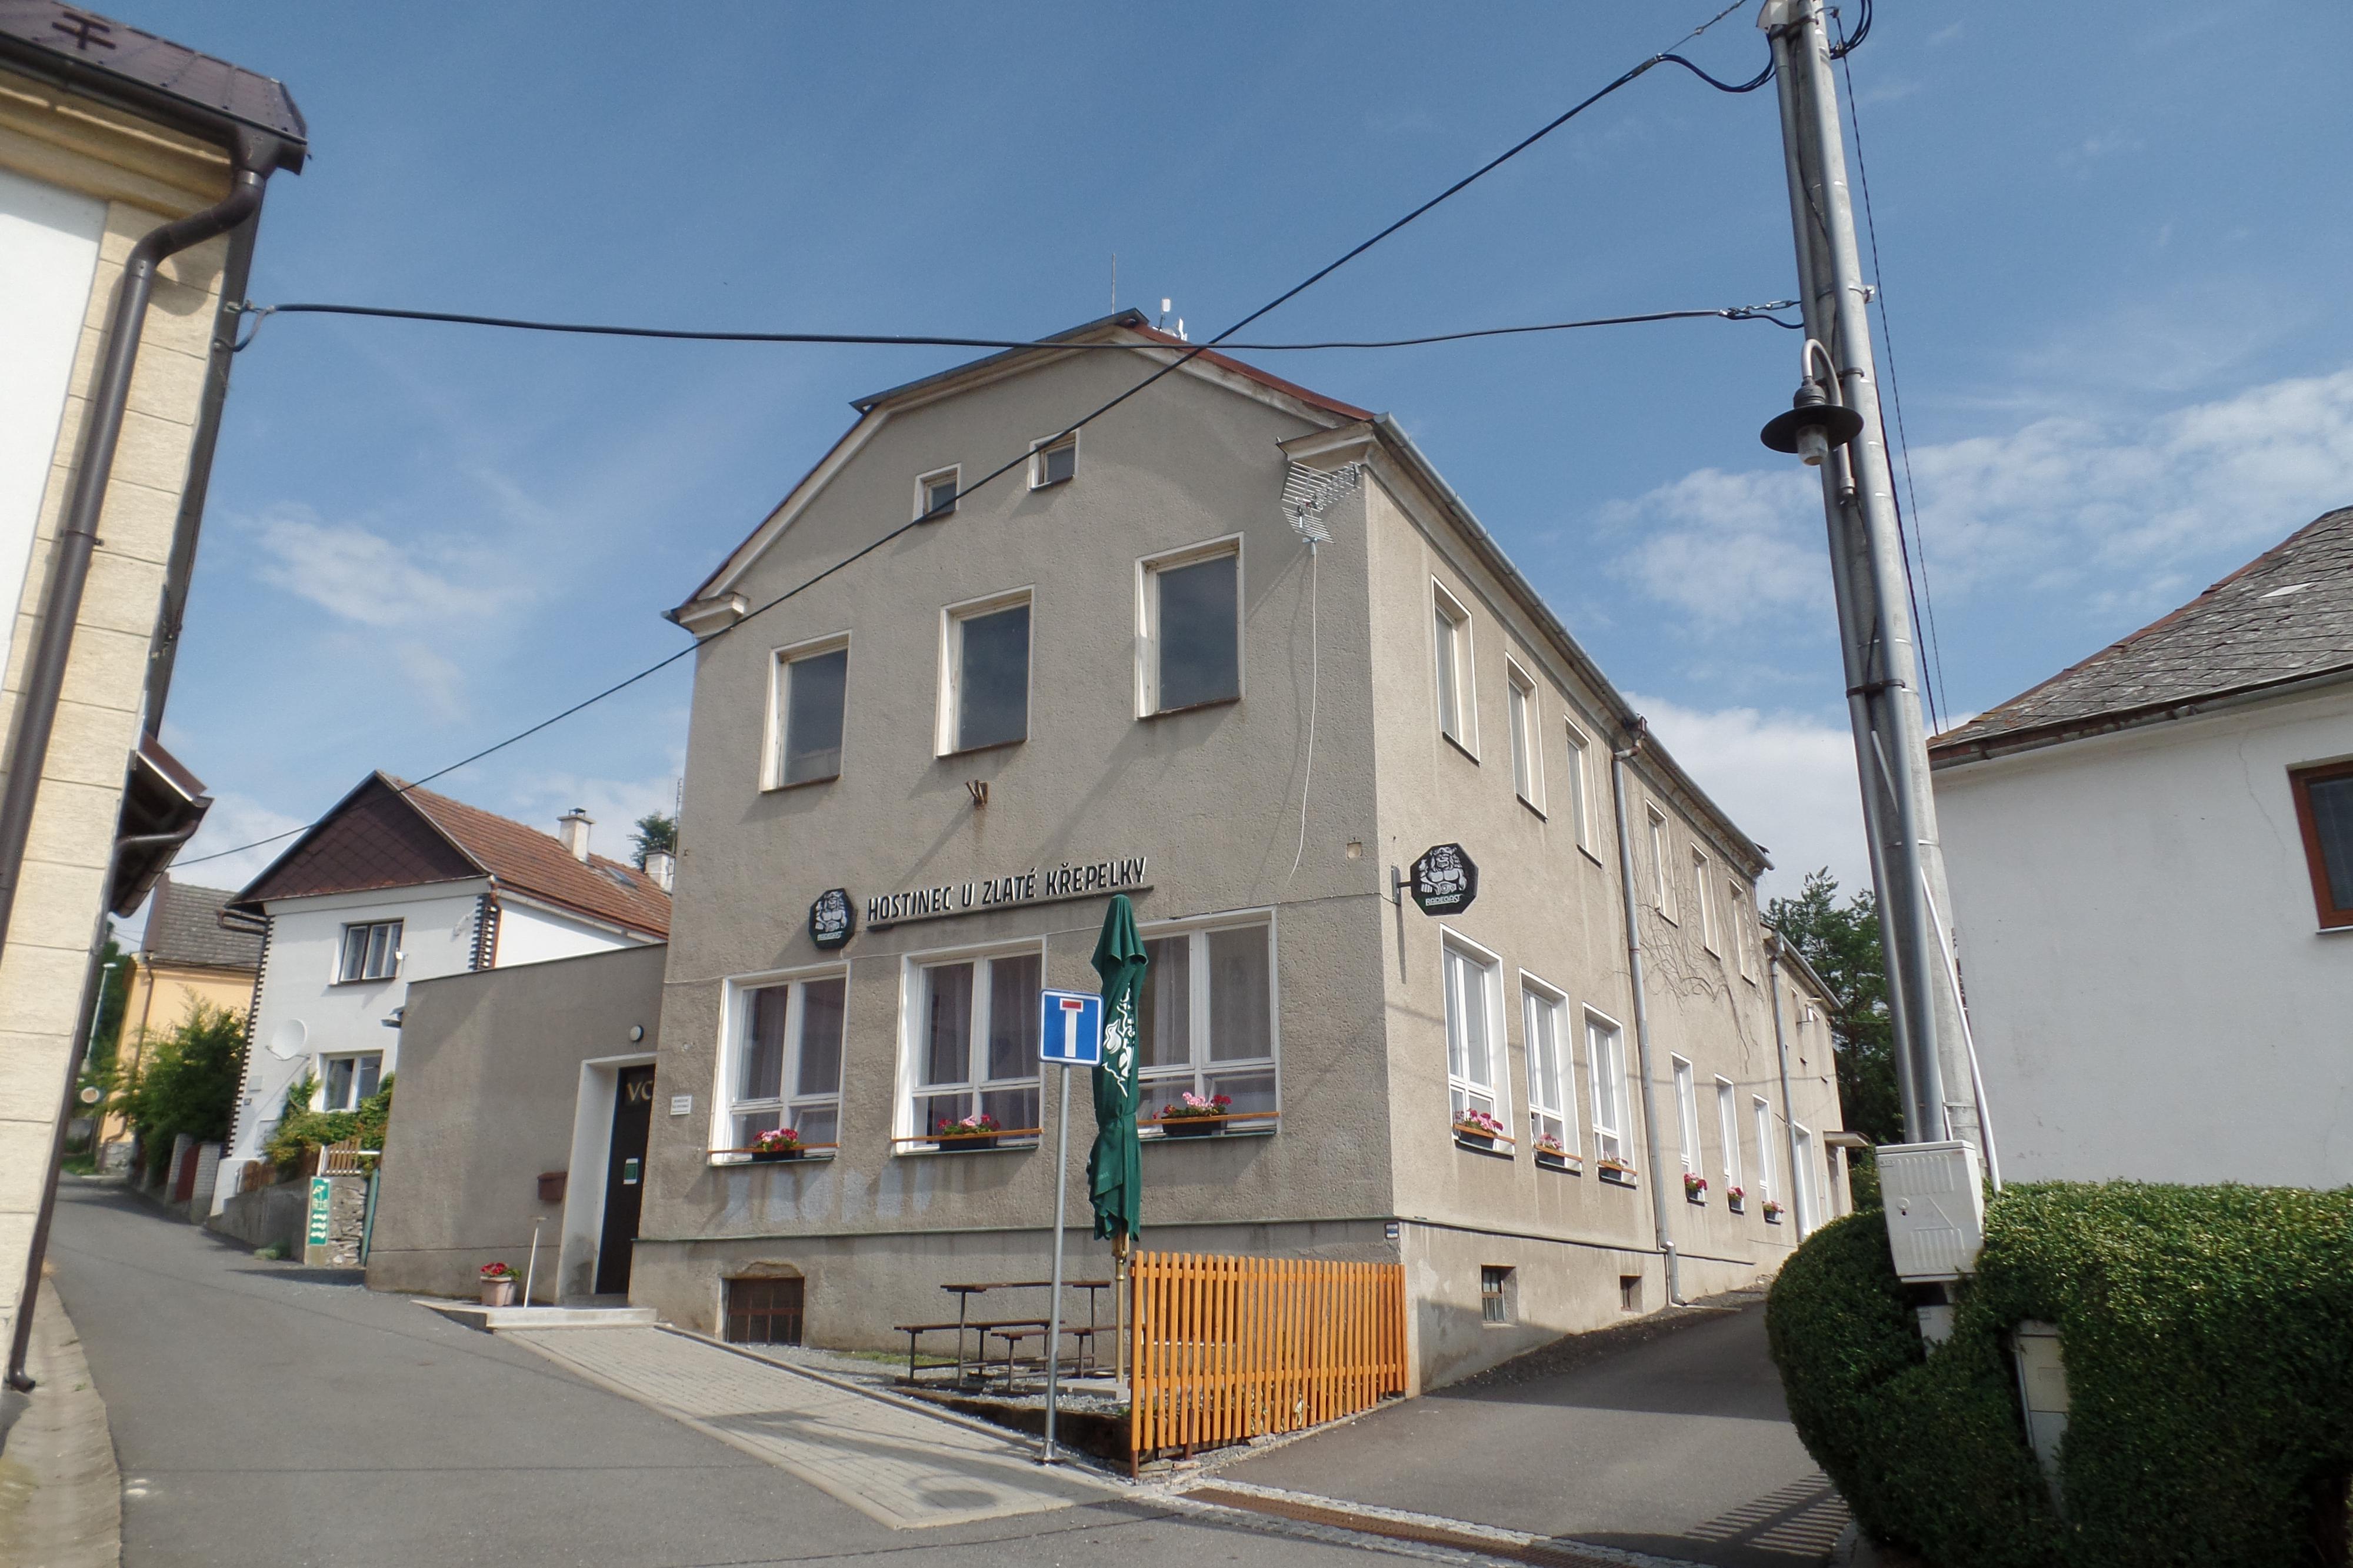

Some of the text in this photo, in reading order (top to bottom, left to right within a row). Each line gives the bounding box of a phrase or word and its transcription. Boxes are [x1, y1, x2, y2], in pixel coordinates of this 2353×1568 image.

[868, 856, 1146, 922] HOSTINEC U ZLATÉ KŘEPELKY
[1426, 894, 1461, 906] RADEGAST
